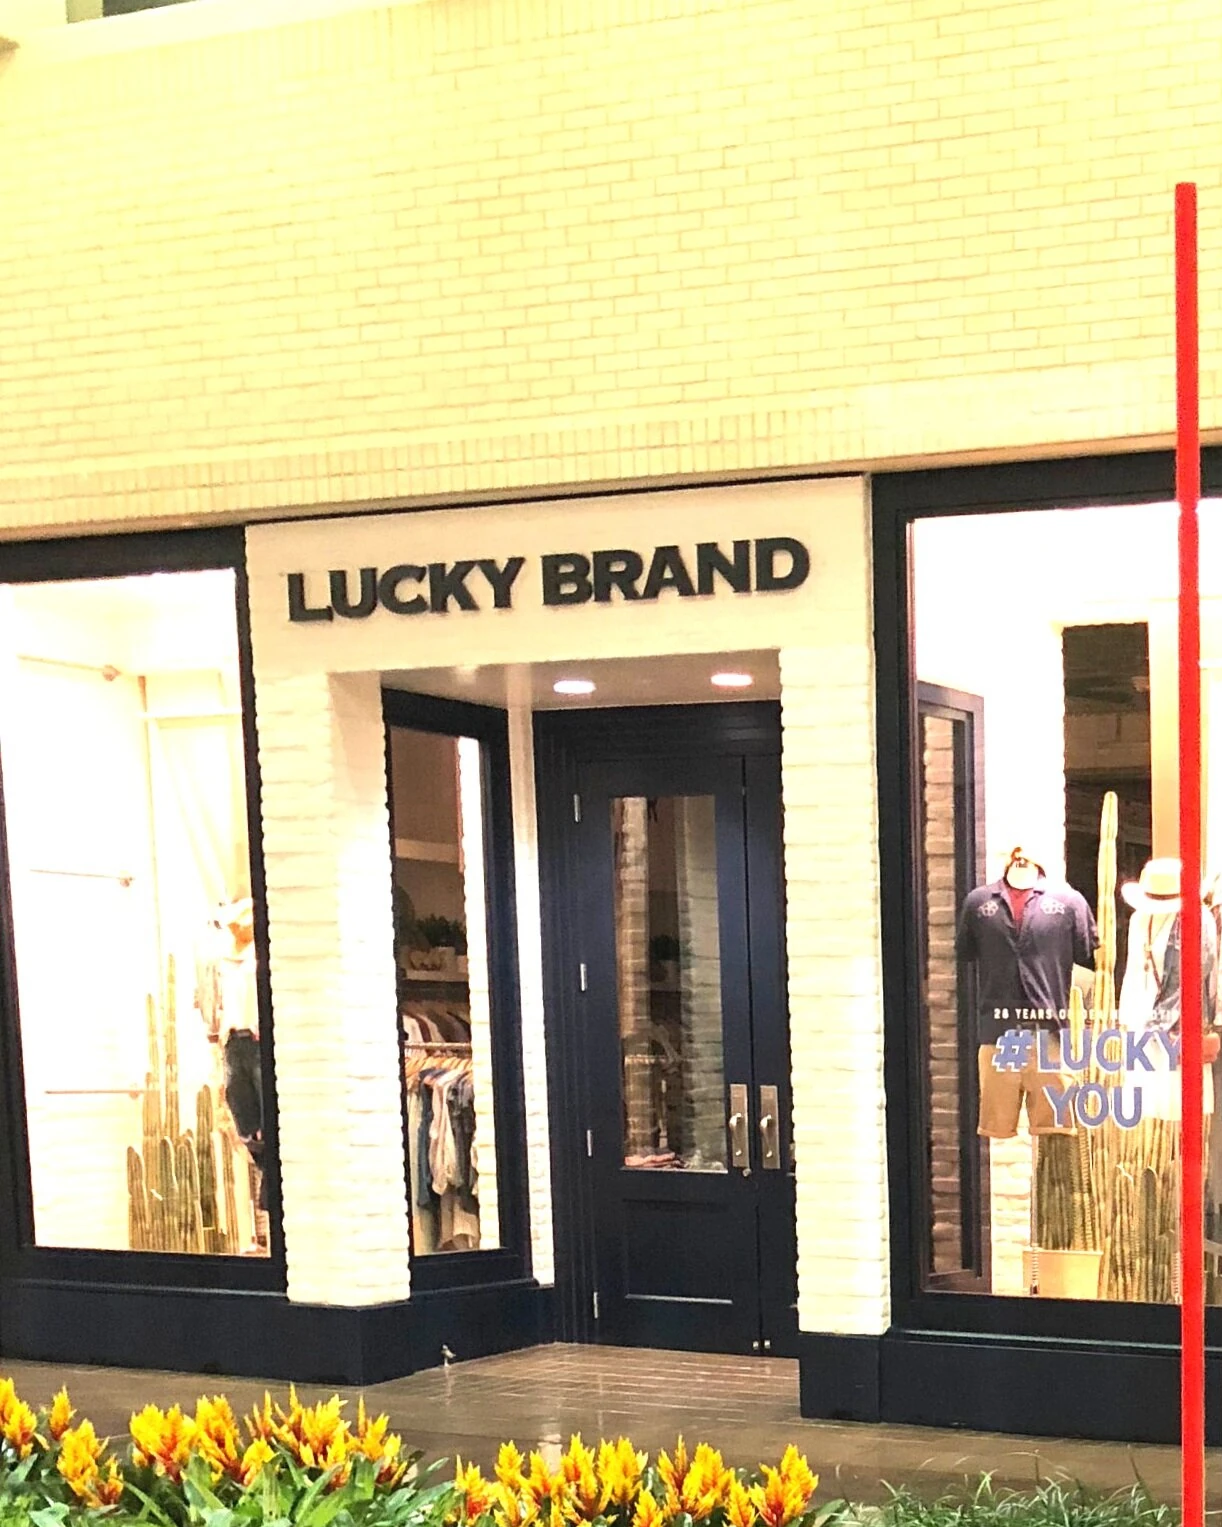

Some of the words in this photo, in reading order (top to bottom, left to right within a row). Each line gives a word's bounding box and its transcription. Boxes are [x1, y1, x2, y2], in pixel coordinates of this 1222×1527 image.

[286, 555, 526, 623] LUCKY
[541, 536, 811, 608] BRAND
[1014, 1007, 1053, 1020] YEARS
[991, 1028, 1182, 1073] #LUCKY
[1042, 1082, 1143, 1129] YOU
